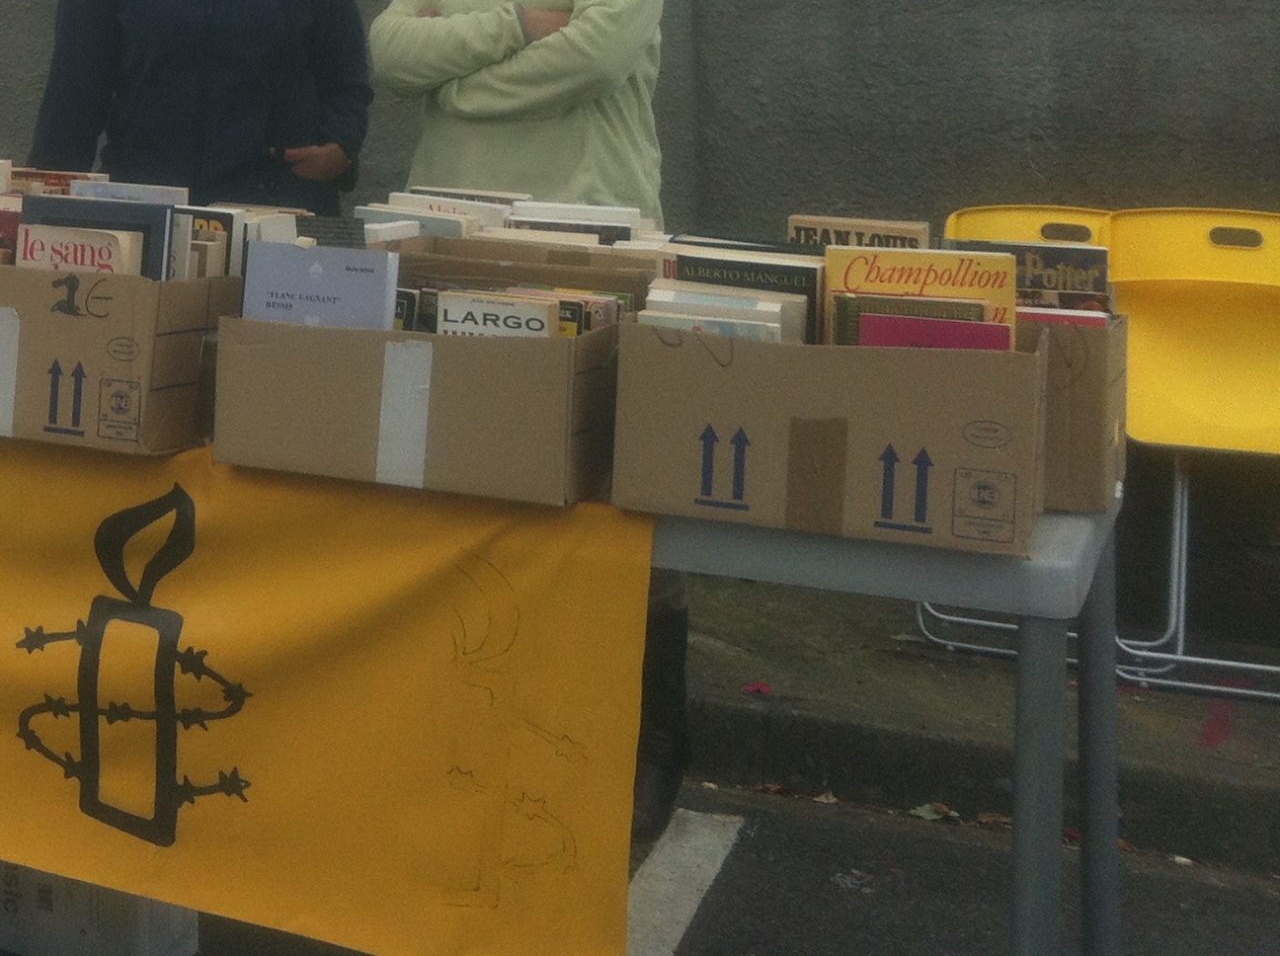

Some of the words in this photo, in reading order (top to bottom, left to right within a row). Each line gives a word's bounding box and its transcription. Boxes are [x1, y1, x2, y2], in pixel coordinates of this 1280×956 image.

[22, 227, 46, 263] le
[50, 241, 114, 274] sang
[789, 225, 851, 246] JEAN
[855, 231, 920, 250] LOUIS
[682, 264, 740, 281] ALBERTO
[842, 254, 1008, 296] Champollion
[1022, 251, 1101, 292] Potter
[442, 308, 546, 333] LARGO
